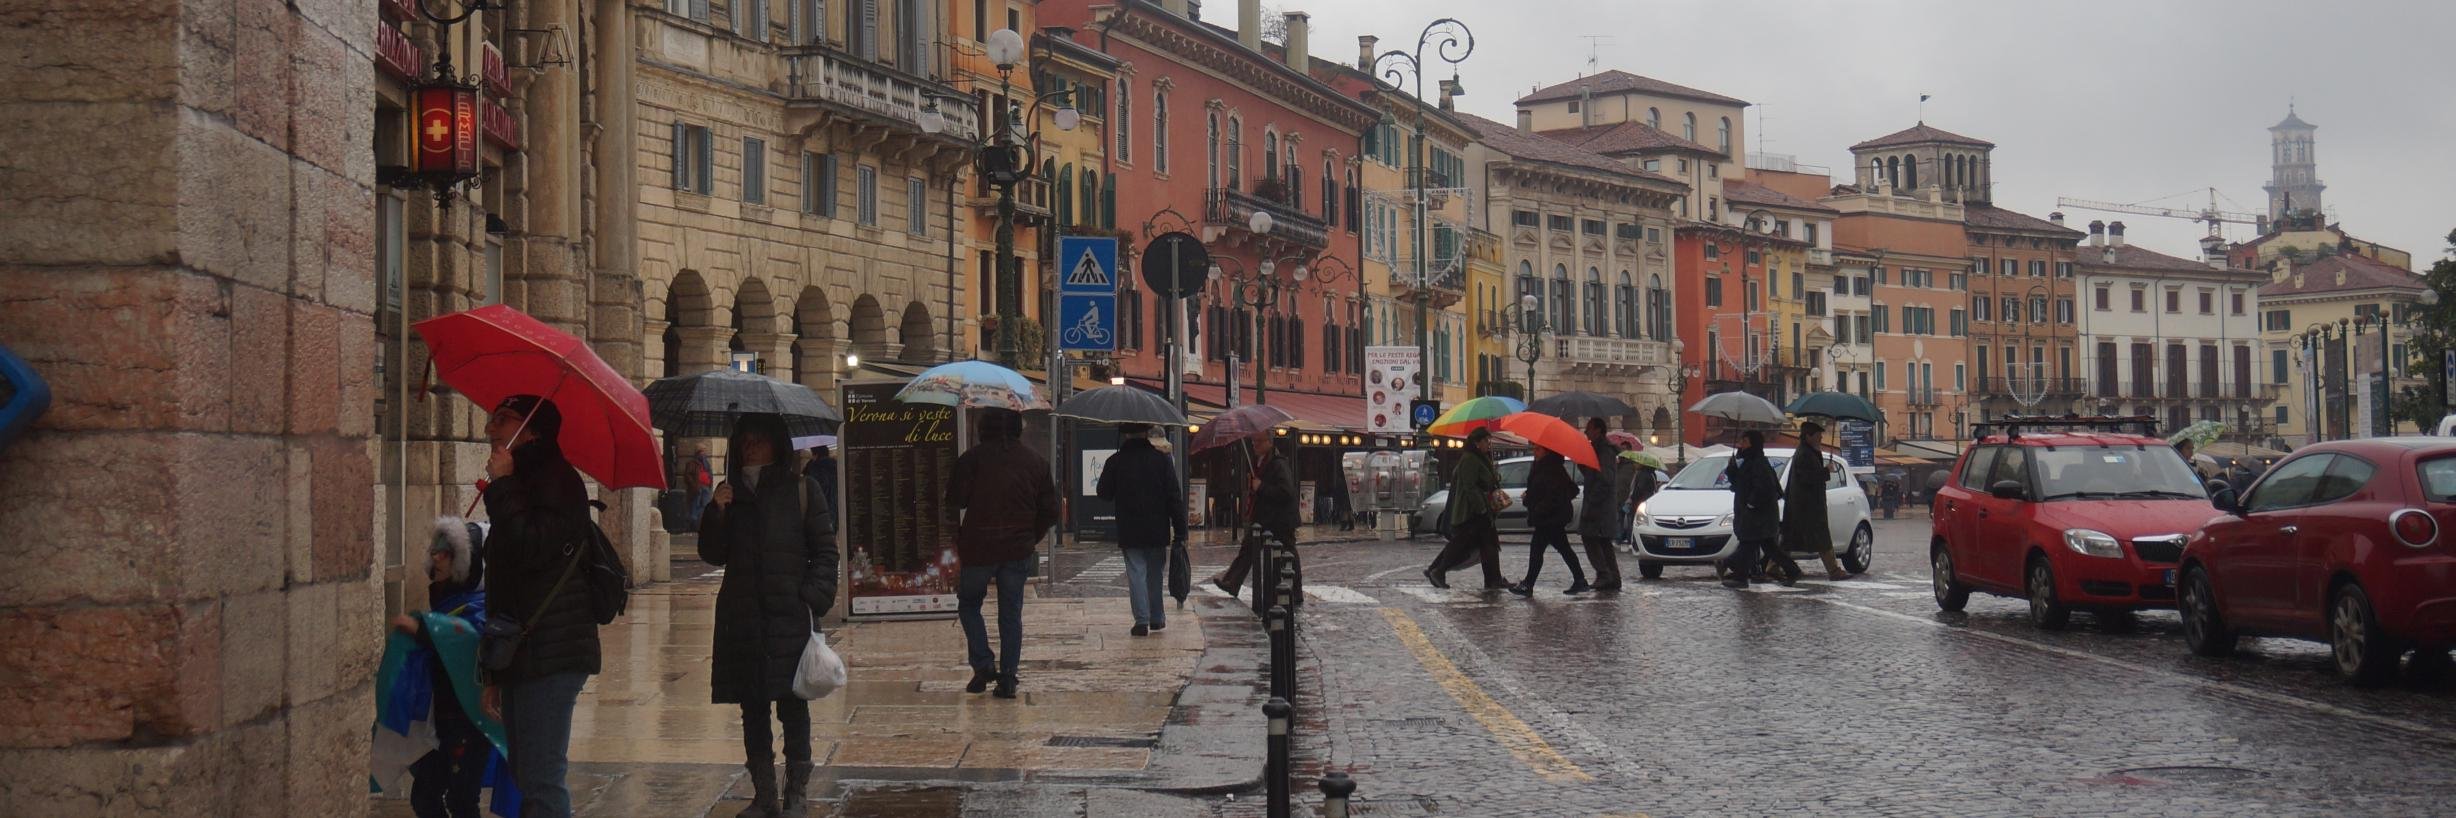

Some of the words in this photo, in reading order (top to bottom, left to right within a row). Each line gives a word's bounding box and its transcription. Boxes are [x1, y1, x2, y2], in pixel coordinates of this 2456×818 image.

[457, 92, 471, 168] FARMACIA
[847, 404, 897, 422] Verona
[900, 408, 914, 421] si
[919, 406, 951, 421] veste
[905, 421, 922, 442] di
[924, 419, 953, 442] luce
